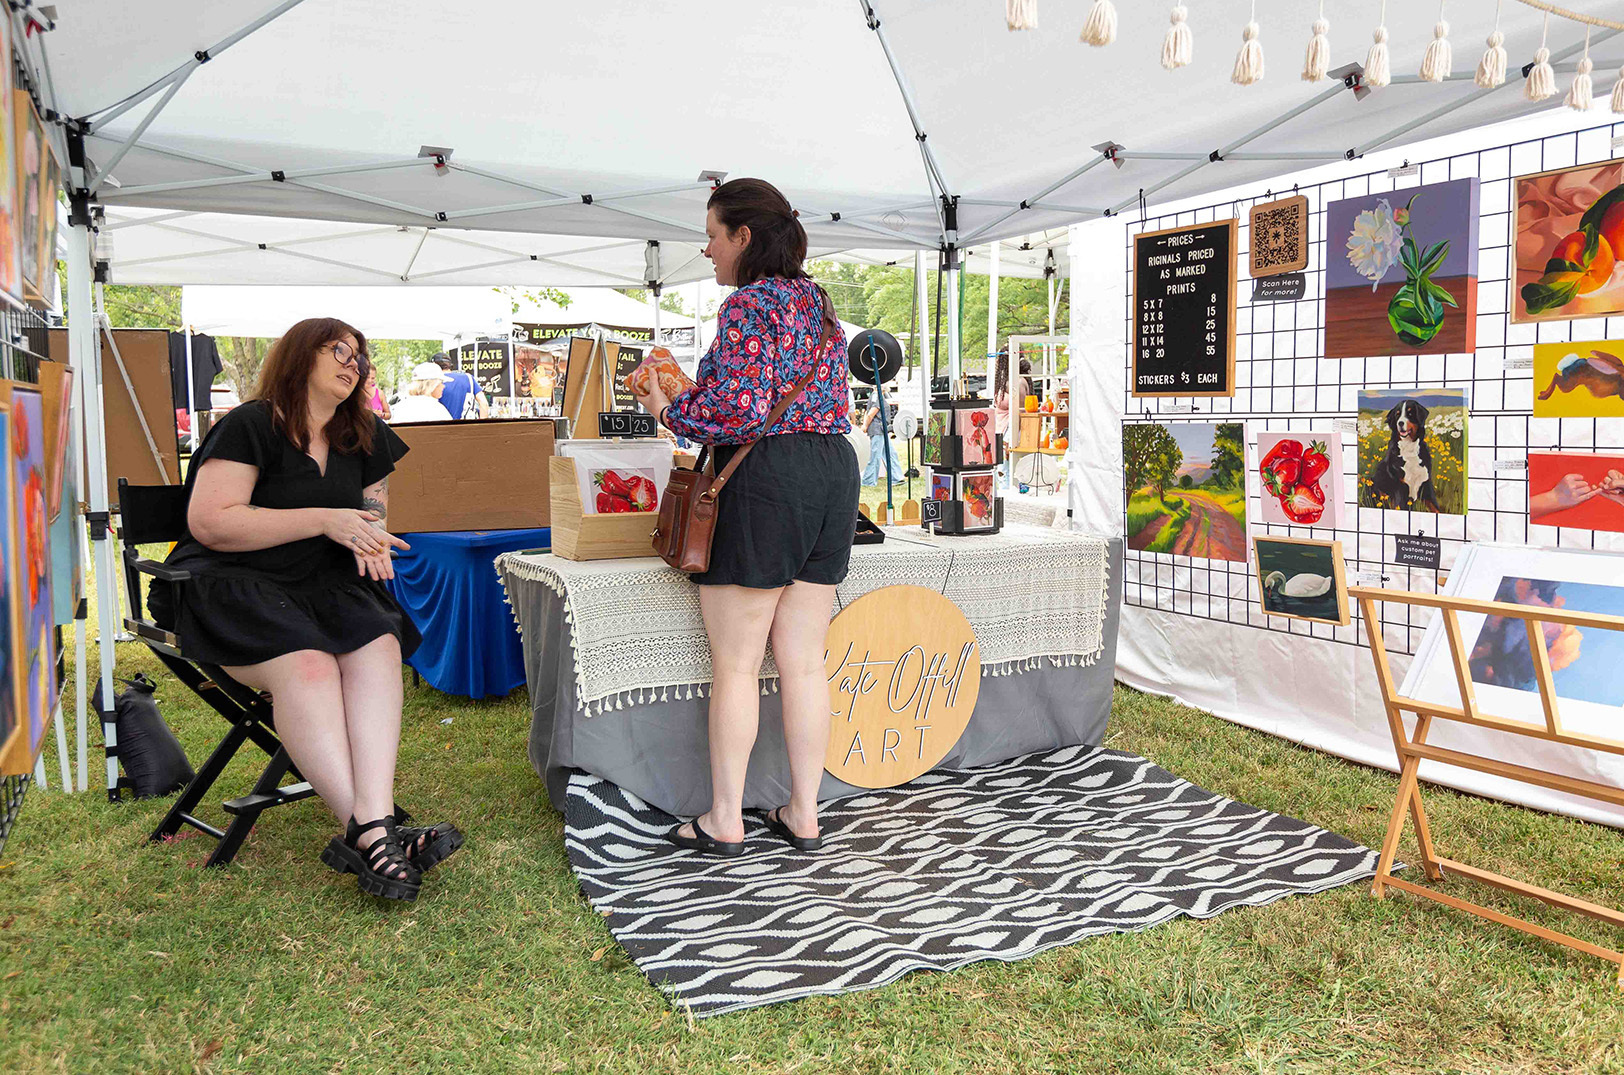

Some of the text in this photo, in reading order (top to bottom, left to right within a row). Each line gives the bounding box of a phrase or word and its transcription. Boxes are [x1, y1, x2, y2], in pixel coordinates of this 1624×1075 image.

[1167, 234, 1194, 247] PRICES
[1148, 248, 1214, 267] RIGINALS PRICED
[1160, 264, 1206, 280] AS MARKED
[1166, 282, 1196, 295] PRINTS
[1210, 293, 1217, 303] 8
[1206, 306, 1216, 317] 15
[1205, 319, 1216, 330] 25
[532, 328, 651, 341] ELEVATE YOR BOOZE
[1205, 332, 1217, 343] 45
[461, 349, 503, 361] LEVATE
[1142, 345, 1216, 359] 16 20 55
[478, 362, 502, 370] BOOZE
[1138, 371, 1218, 385] STICKERS $3 EACH
[843, 725, 932, 766] ART
